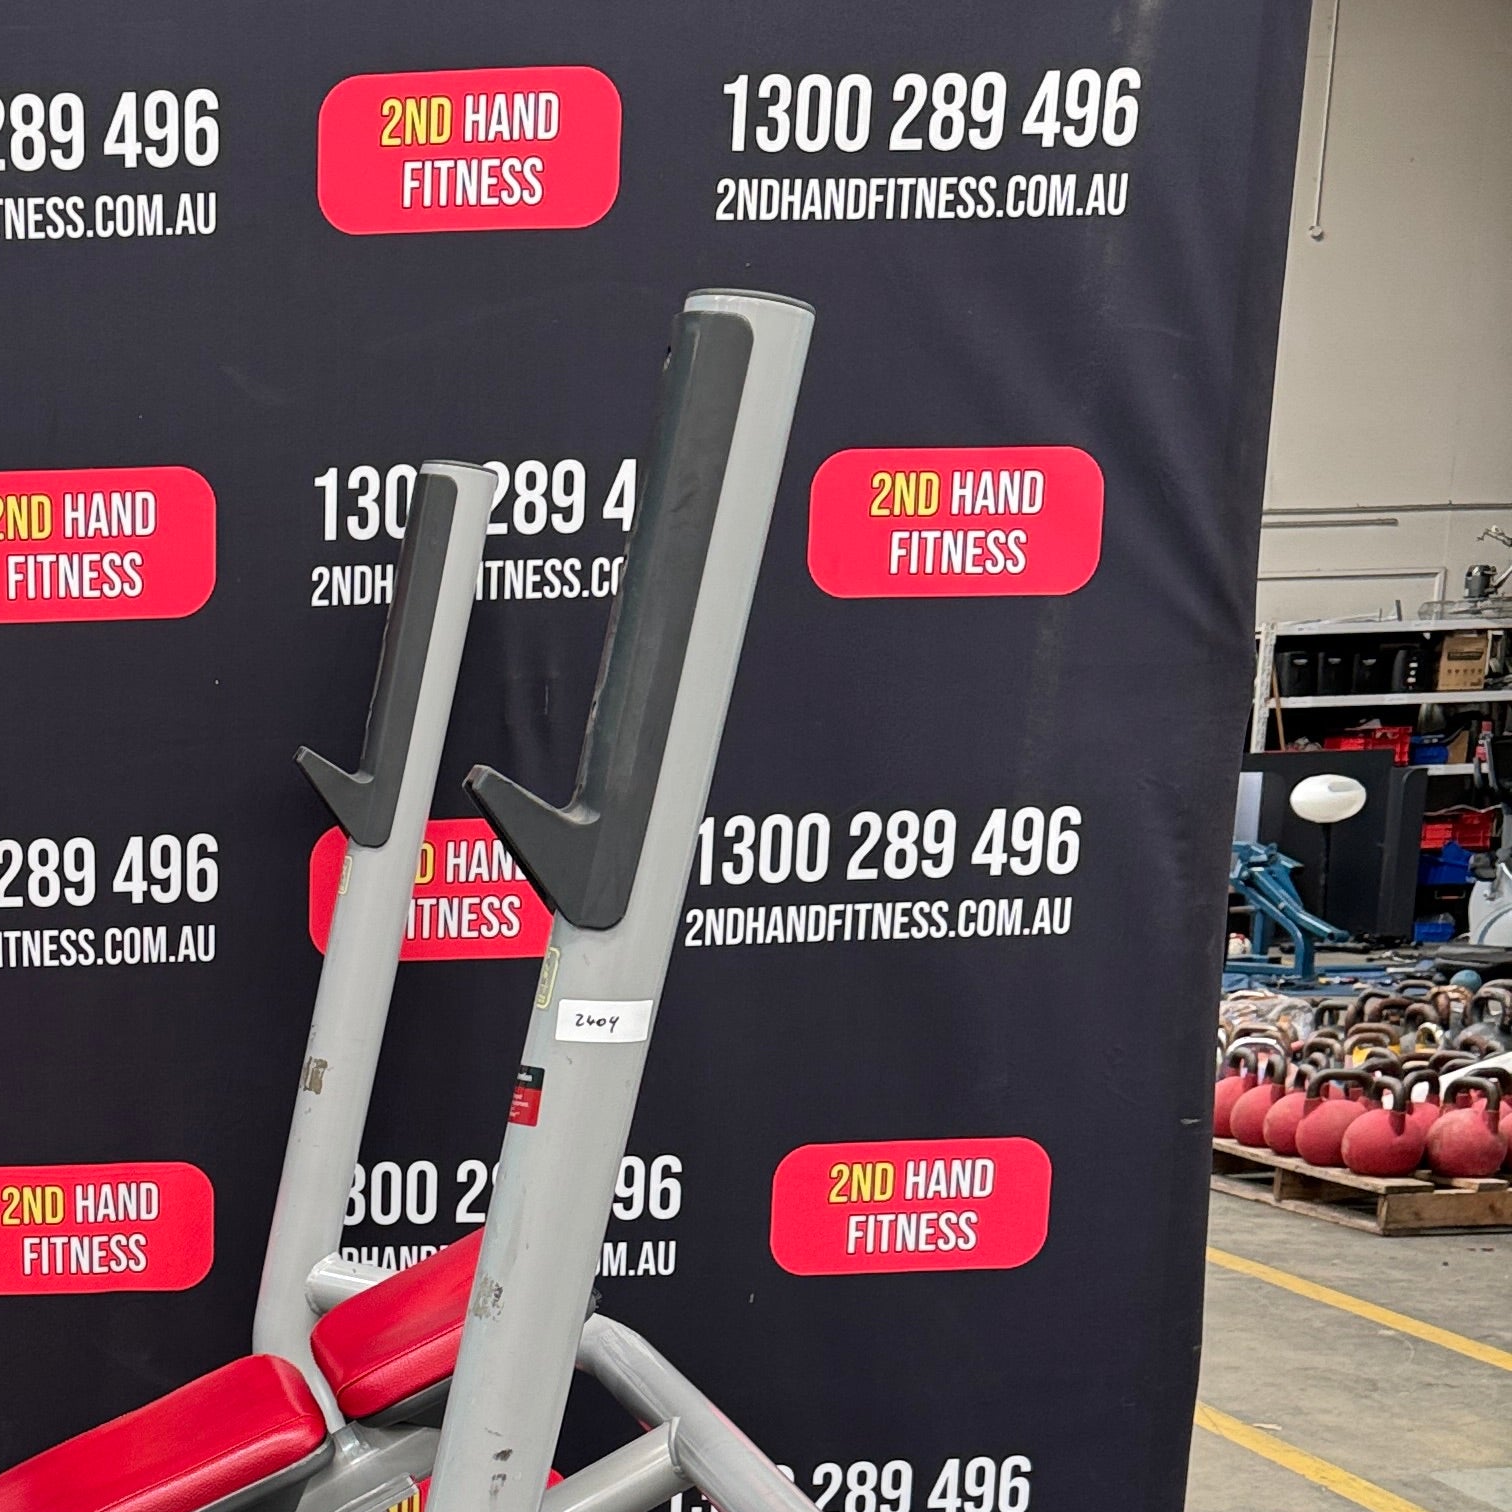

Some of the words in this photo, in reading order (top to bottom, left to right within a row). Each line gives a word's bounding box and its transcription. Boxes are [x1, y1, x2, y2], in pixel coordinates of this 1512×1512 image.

[103, 88, 220, 169] 496
[381, 96, 452, 146] 2ND
[464, 92, 559, 142] HAND
[723, 73, 873, 153] 1300
[888, 71, 1007, 152] 289
[1021, 66, 1142, 148] 496
[403, 156, 544, 208] FITNESS
[715, 172, 1129, 221] 2NDHANDFITNESS.COM.AU
[64, 491, 156, 538] HAND
[314, 463, 418, 541] 130
[482, 458, 586, 536] 289
[870, 471, 940, 516] 2ND
[951, 470, 1044, 515] HAND
[7, 551, 143, 600] FITNESS
[890, 529, 1027, 574] FITNESS
[112, 832, 219, 904] 496
[445, 840, 526, 884] HAN
[696, 813, 831, 886] 1300
[847, 809, 956, 880] 289
[971, 806, 1081, 876] 496
[406, 895, 521, 940] ITNESS
[685, 896, 1073, 947] 2NDHANDFITNESS.COM.AU
[2, 1186, 64, 1225] 2ND
[75, 1182, 159, 1223] HAND
[343, 1160, 439, 1226] 300
[611, 1154, 684, 1221] 96
[829, 1162, 895, 1203] 2ND
[904, 1158, 995, 1200] HAND
[23, 1233, 147, 1275] FITNESS
[847, 1211, 978, 1254] FITNESS
